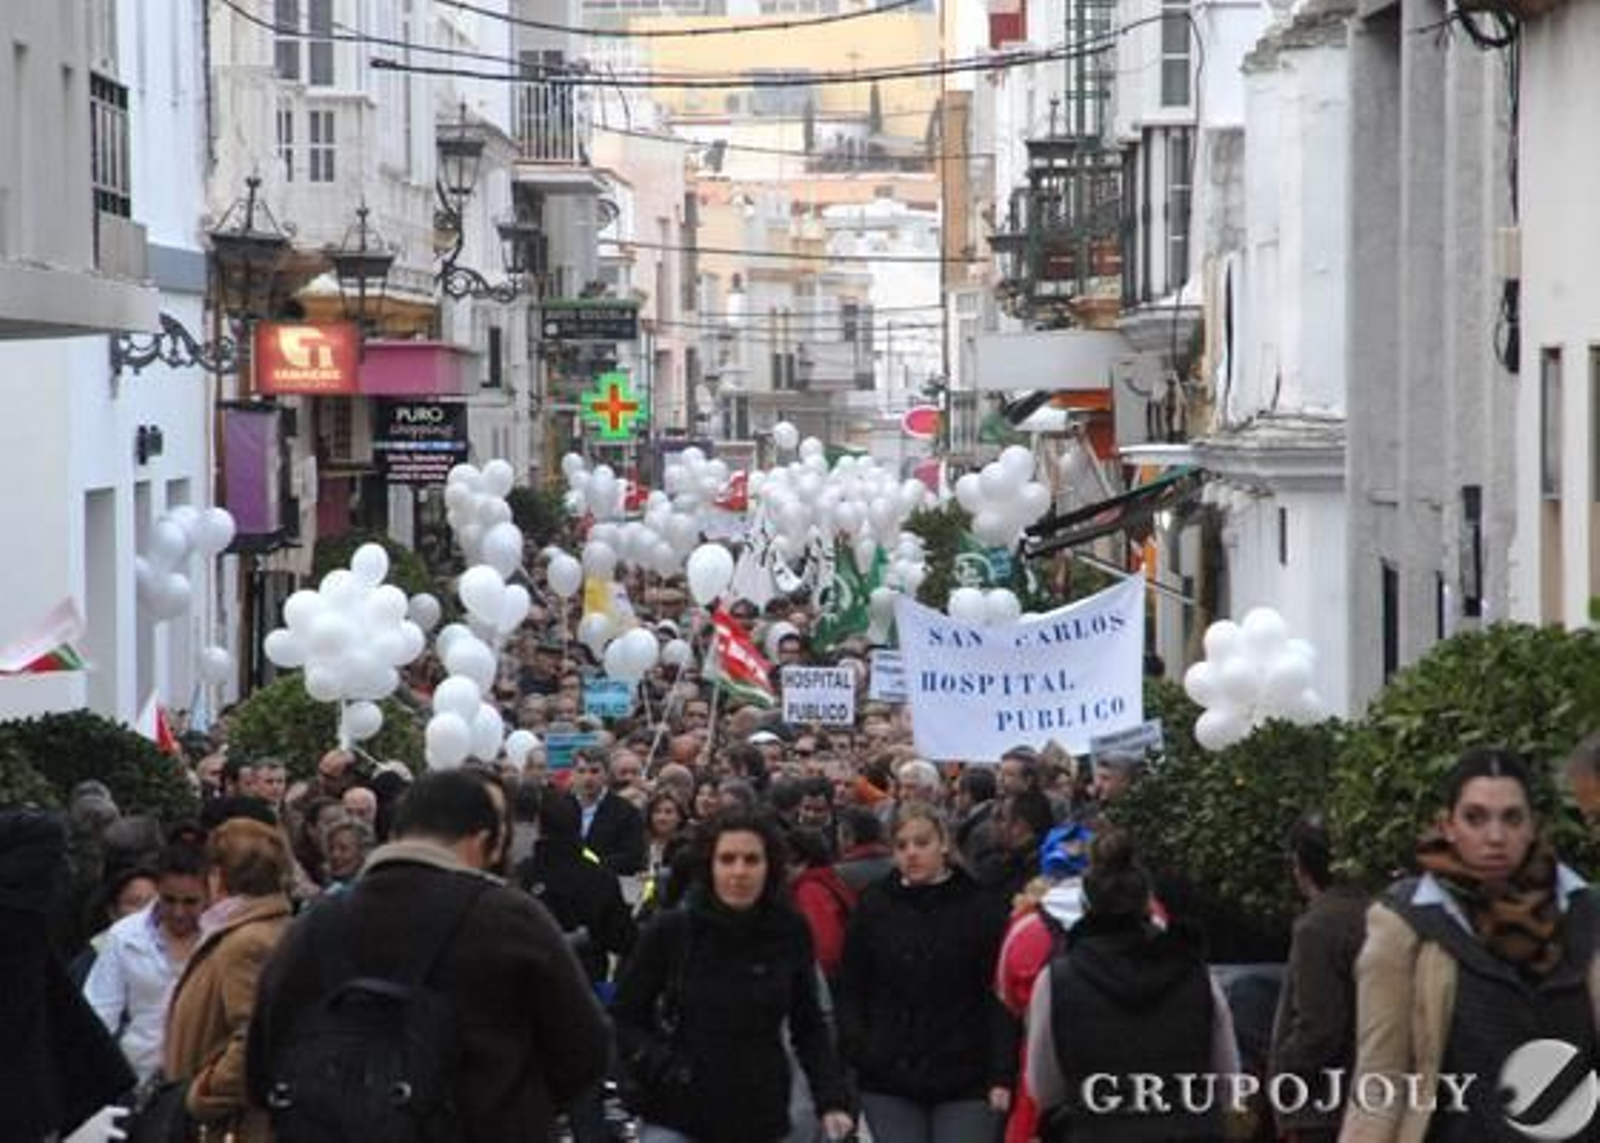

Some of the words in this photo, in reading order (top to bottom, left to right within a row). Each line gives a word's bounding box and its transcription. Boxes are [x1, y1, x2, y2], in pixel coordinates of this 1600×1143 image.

[394, 406, 444, 422] PURO
[928, 626, 985, 648] SAN
[783, 669, 851, 689] HOSPITAL
[920, 670, 1075, 696] HOSPITAL
[787, 703, 849, 720] PUBLICO
[996, 696, 1126, 732] PUBLICO
